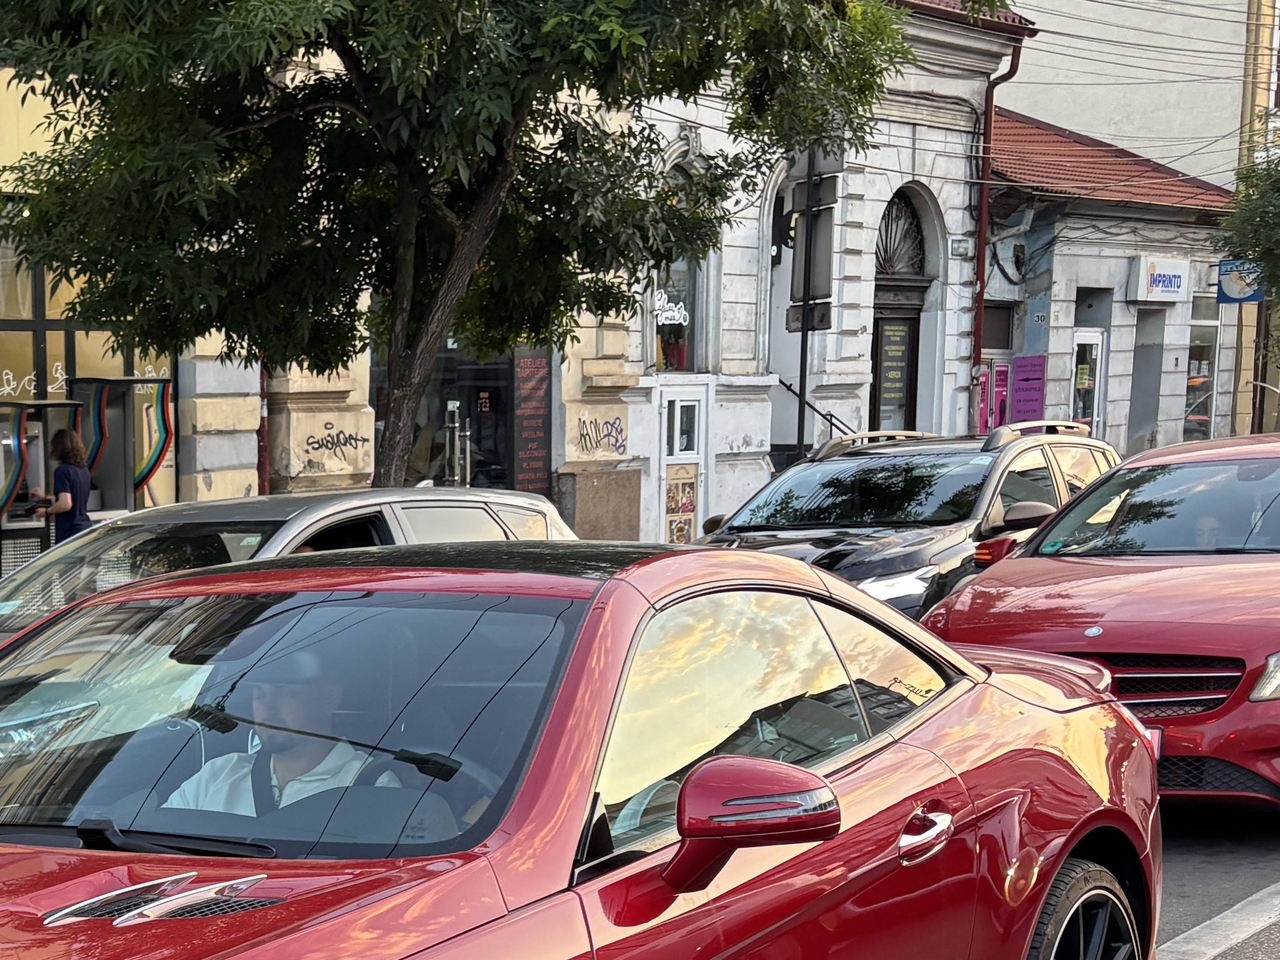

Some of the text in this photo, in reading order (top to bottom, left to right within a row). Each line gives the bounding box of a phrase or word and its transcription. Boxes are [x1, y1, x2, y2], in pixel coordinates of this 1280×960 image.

[1150, 273, 1182, 289] IMPRINTO
[1034, 314, 1046, 323] 30
[519, 358, 547, 367] ATELIER
